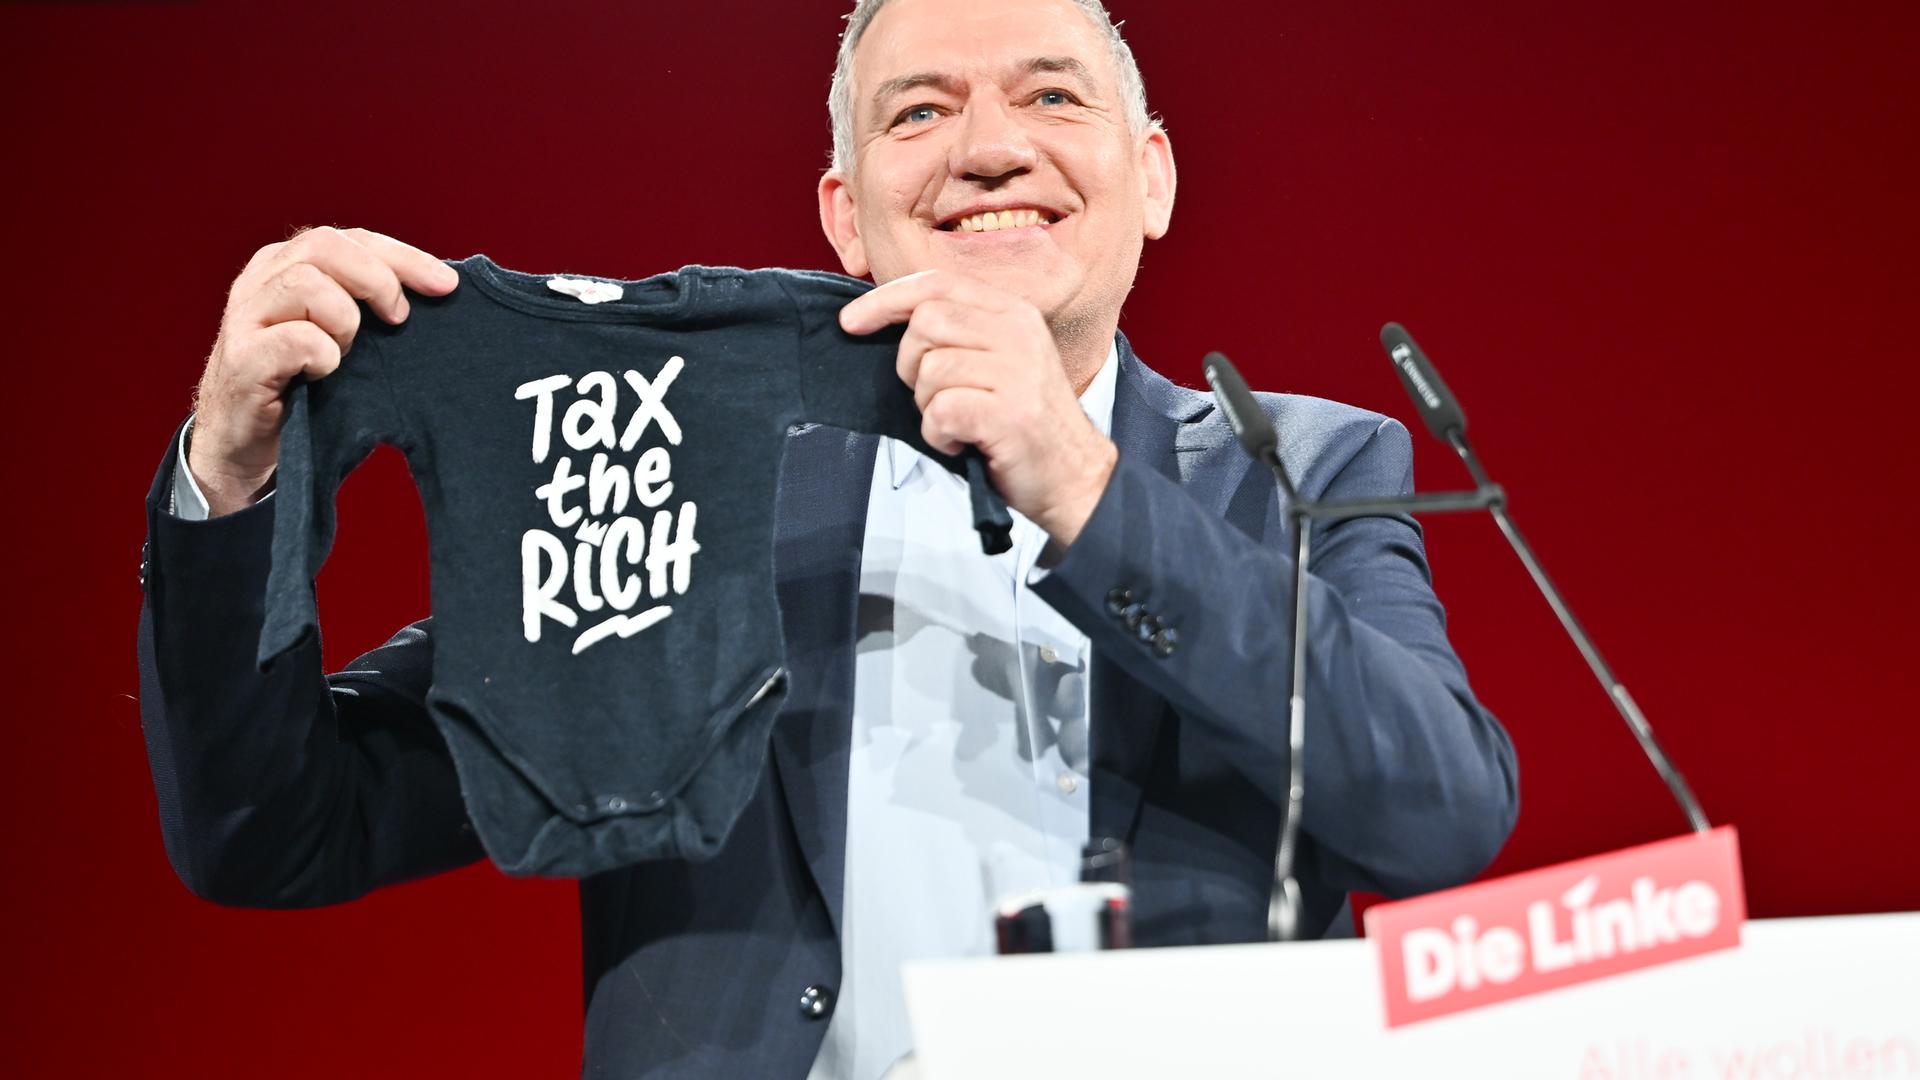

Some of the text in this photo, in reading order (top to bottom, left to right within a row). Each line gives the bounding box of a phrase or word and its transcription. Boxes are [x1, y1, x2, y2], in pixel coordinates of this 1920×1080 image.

[535, 446, 674, 528] the
[1402, 875, 1720, 1001] Die Linke
[1578, 1023, 1920, 1080] Alle wollen
